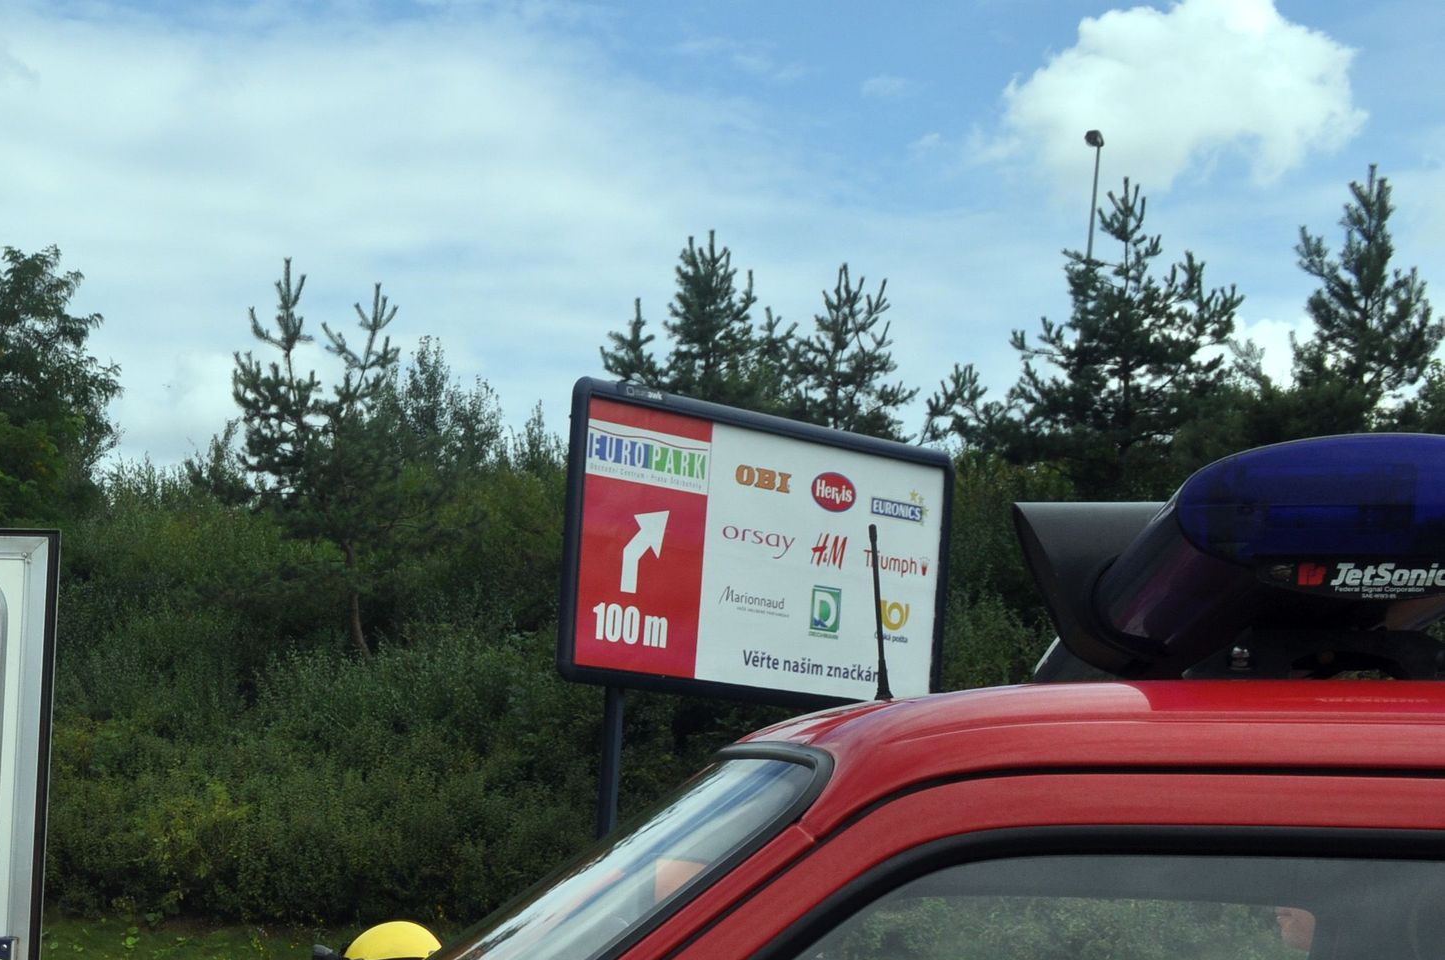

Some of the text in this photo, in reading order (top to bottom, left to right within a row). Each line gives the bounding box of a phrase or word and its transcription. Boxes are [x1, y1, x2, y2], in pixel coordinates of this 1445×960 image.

[735, 464, 792, 494] OBI
[815, 478, 853, 505] Hervis
[871, 499, 923, 521] EURONICS
[722, 525, 795, 559] orsay
[863, 549, 917, 578] Tumph
[718, 586, 785, 610] Marionnaud
[1362, 586, 1383, 594] Signal
[1384, 586, 1425, 594] Corporation
[593, 602, 668, 649] 100 m
[743, 649, 779, 671] Věřte
[783, 657, 823, 676] našim
